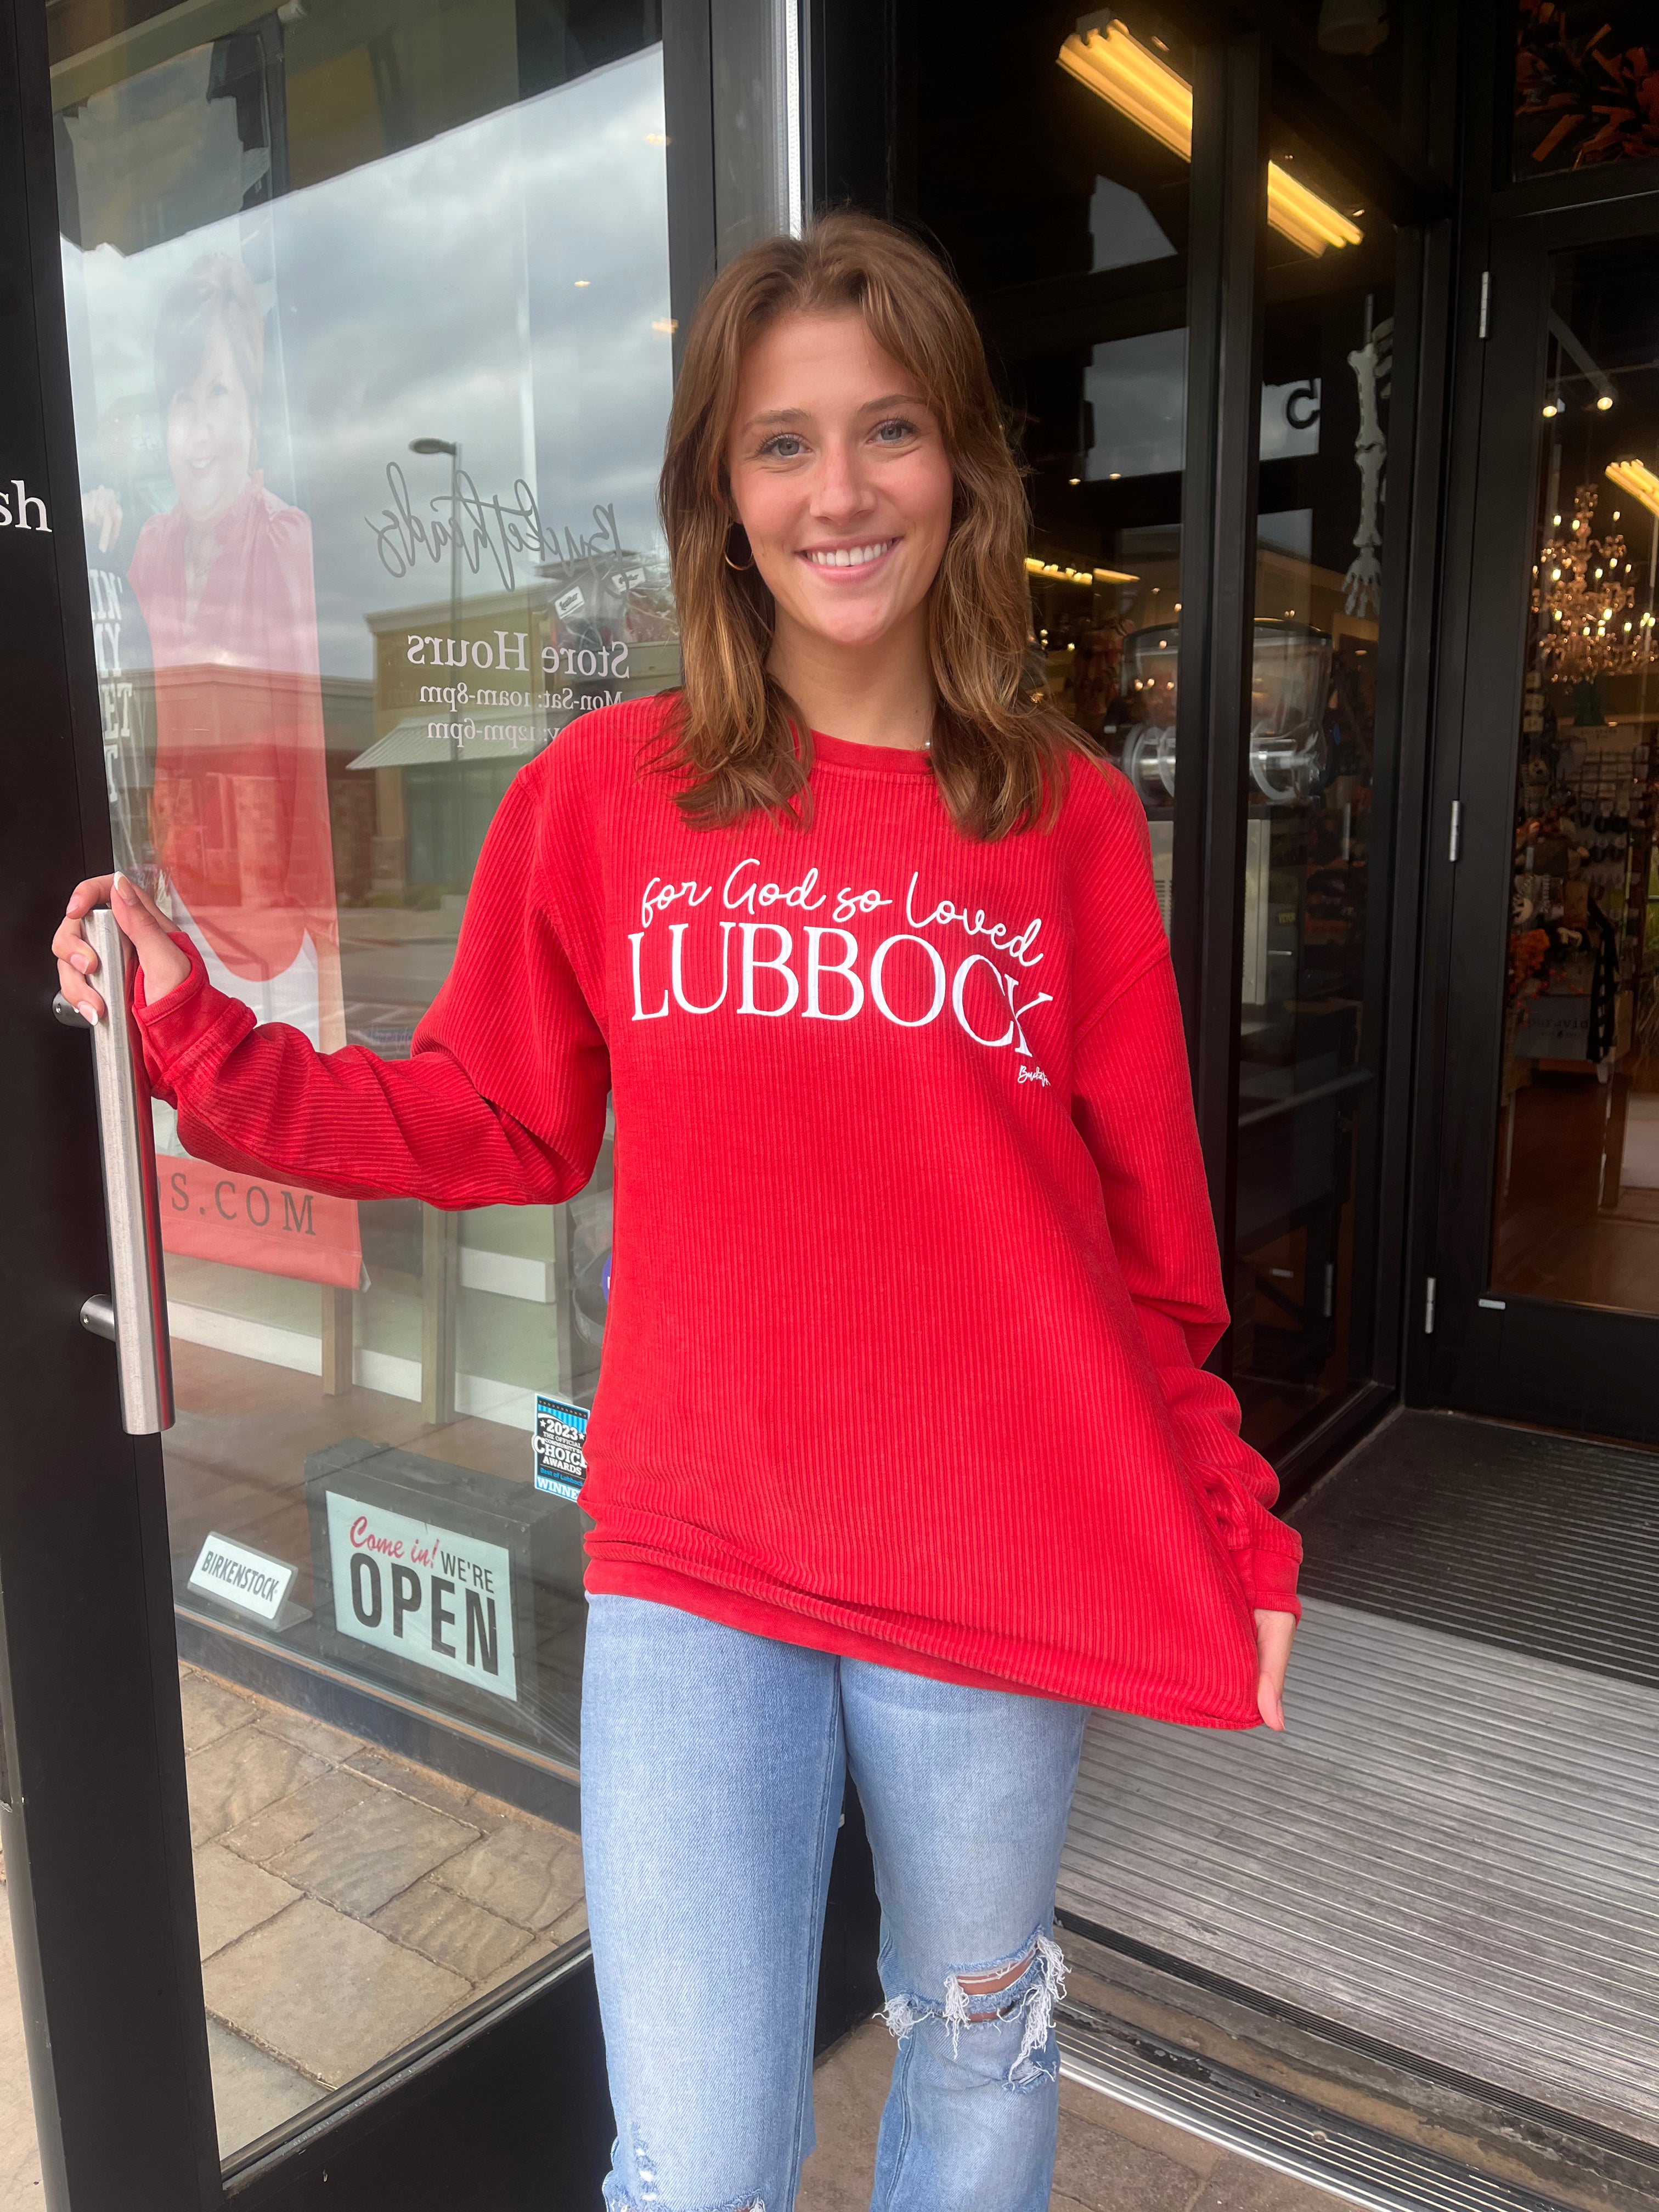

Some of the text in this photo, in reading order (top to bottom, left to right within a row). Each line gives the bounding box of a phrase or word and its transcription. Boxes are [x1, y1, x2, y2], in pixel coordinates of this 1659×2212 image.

[642, 877, 712, 928] for
[723, 858, 827, 915] God
[832, 886, 893, 923] so
[627, 921, 1053, 1058] LUBBOCK
[157, 1172, 317, 1236] S.COM
[546, 1419, 578, 1441] 2023
[537, 1476, 579, 1498] WINNE
[543, 1457, 582, 1475] AWARDS
[201, 1550, 279, 1602] BIRKENSTOCK
[349, 1516, 495, 1594] Come in! WE'RE
[349, 1551, 499, 1676] OPEN
